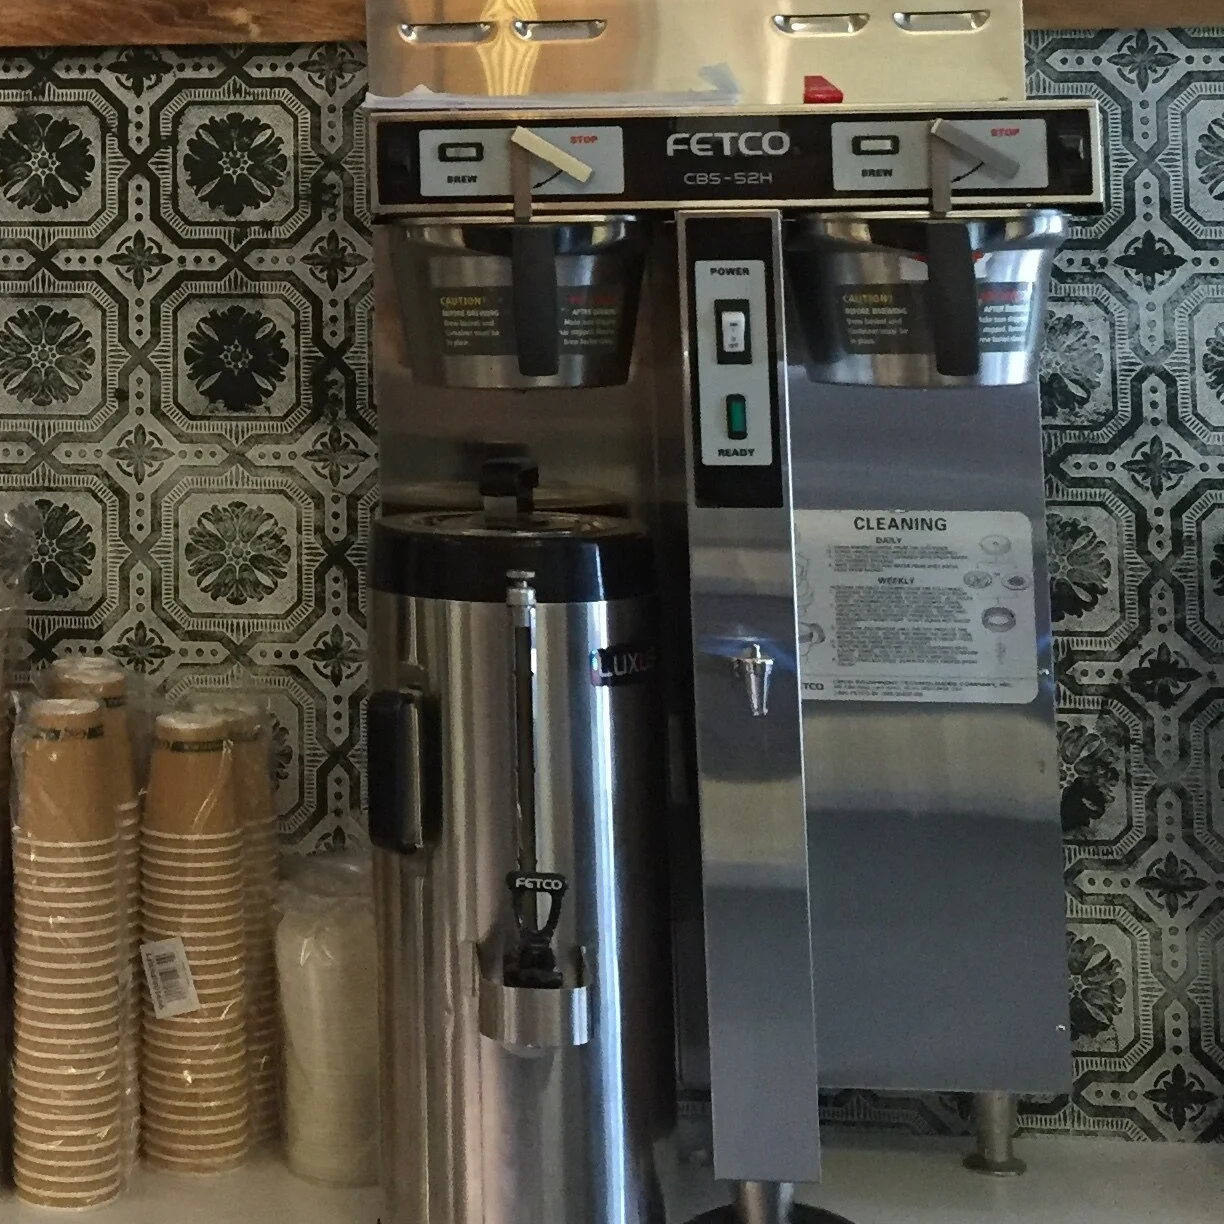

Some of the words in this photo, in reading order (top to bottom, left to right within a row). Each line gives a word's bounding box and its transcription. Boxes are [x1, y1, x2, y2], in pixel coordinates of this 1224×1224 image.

[990, 128, 1020, 137] STOP
[570, 136, 597, 144] STOP
[667, 132, 790, 156] FETCO
[862, 168, 893, 177] BREW
[447, 175, 477, 184] BREW
[684, 172, 772, 185] CBS-52H
[710, 267, 750, 276] POWER
[718, 449, 755, 457] READY
[853, 516, 947, 531] CLEANING
[515, 877, 562, 890] FETCO
